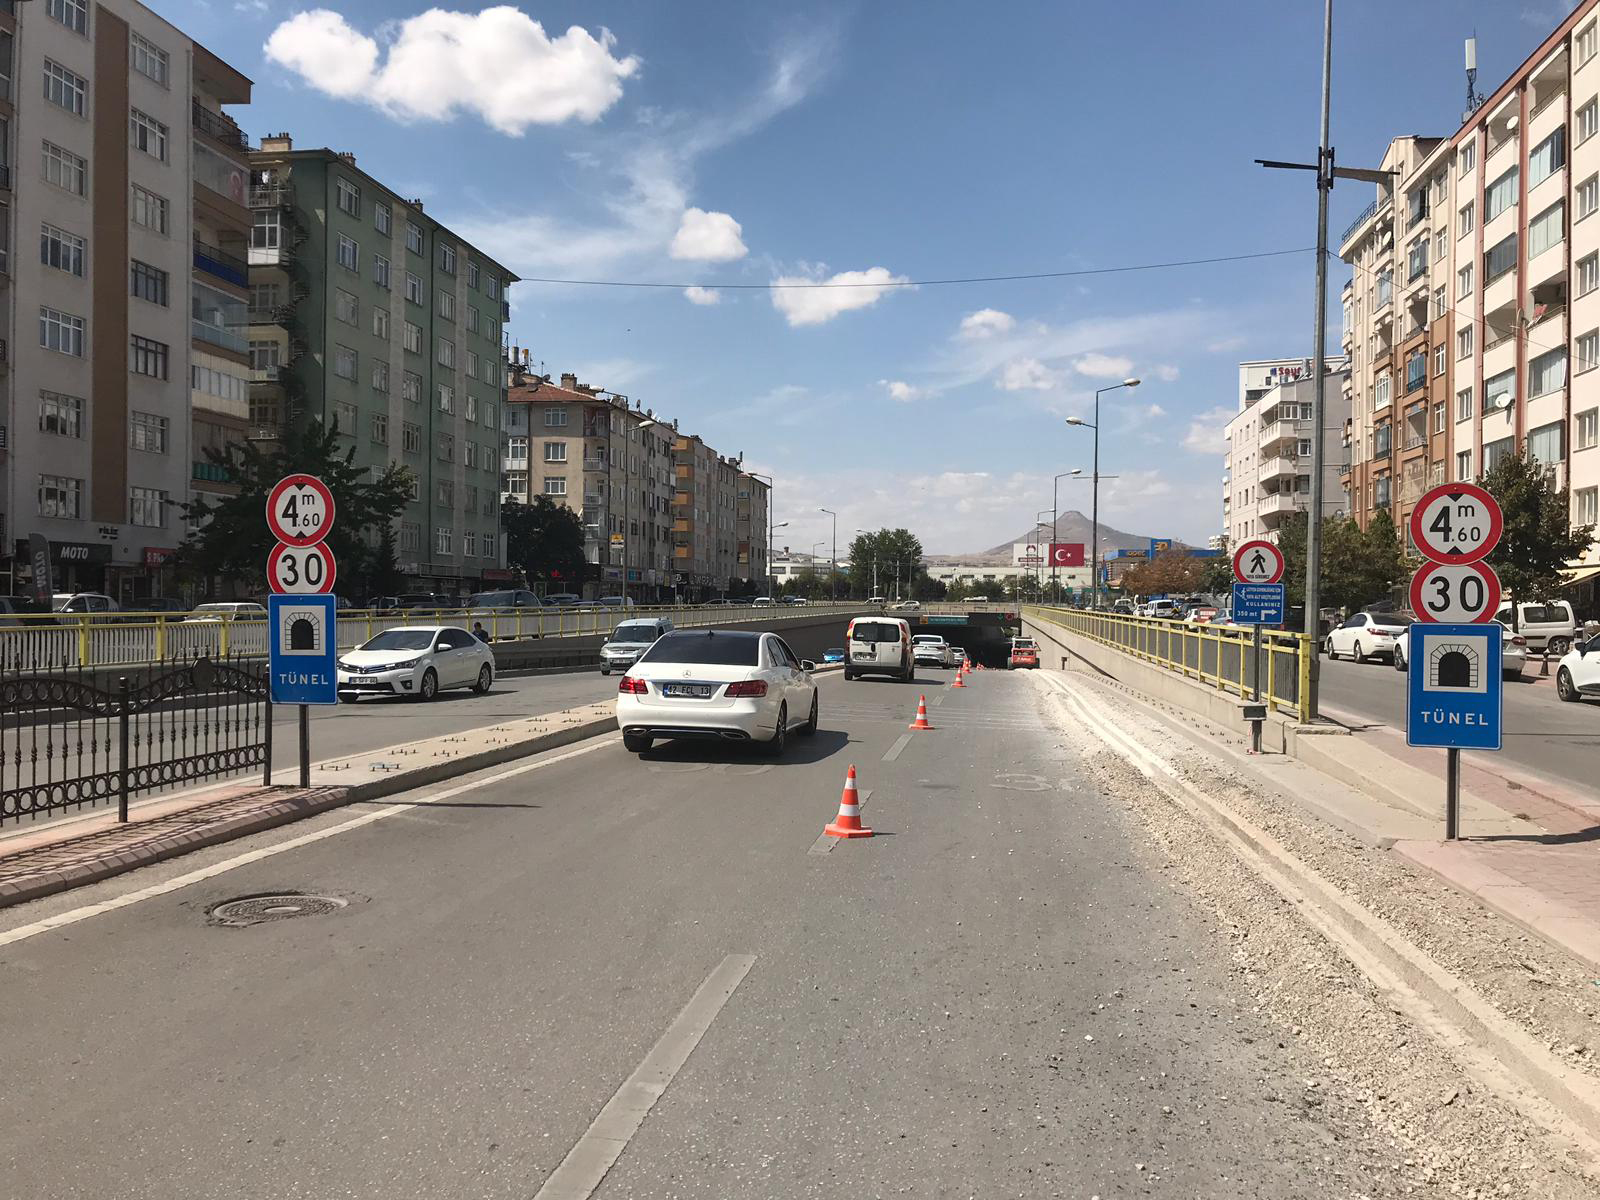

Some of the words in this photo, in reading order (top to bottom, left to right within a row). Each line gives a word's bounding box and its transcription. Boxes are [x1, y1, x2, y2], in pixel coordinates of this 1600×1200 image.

[60, 546, 89, 560] MOTO
[281, 553, 322, 586] 30
[1428, 576, 1484, 612] 30
[279, 671, 329, 685] TÜNEL
[1421, 708, 1488, 726] TÜNEL
